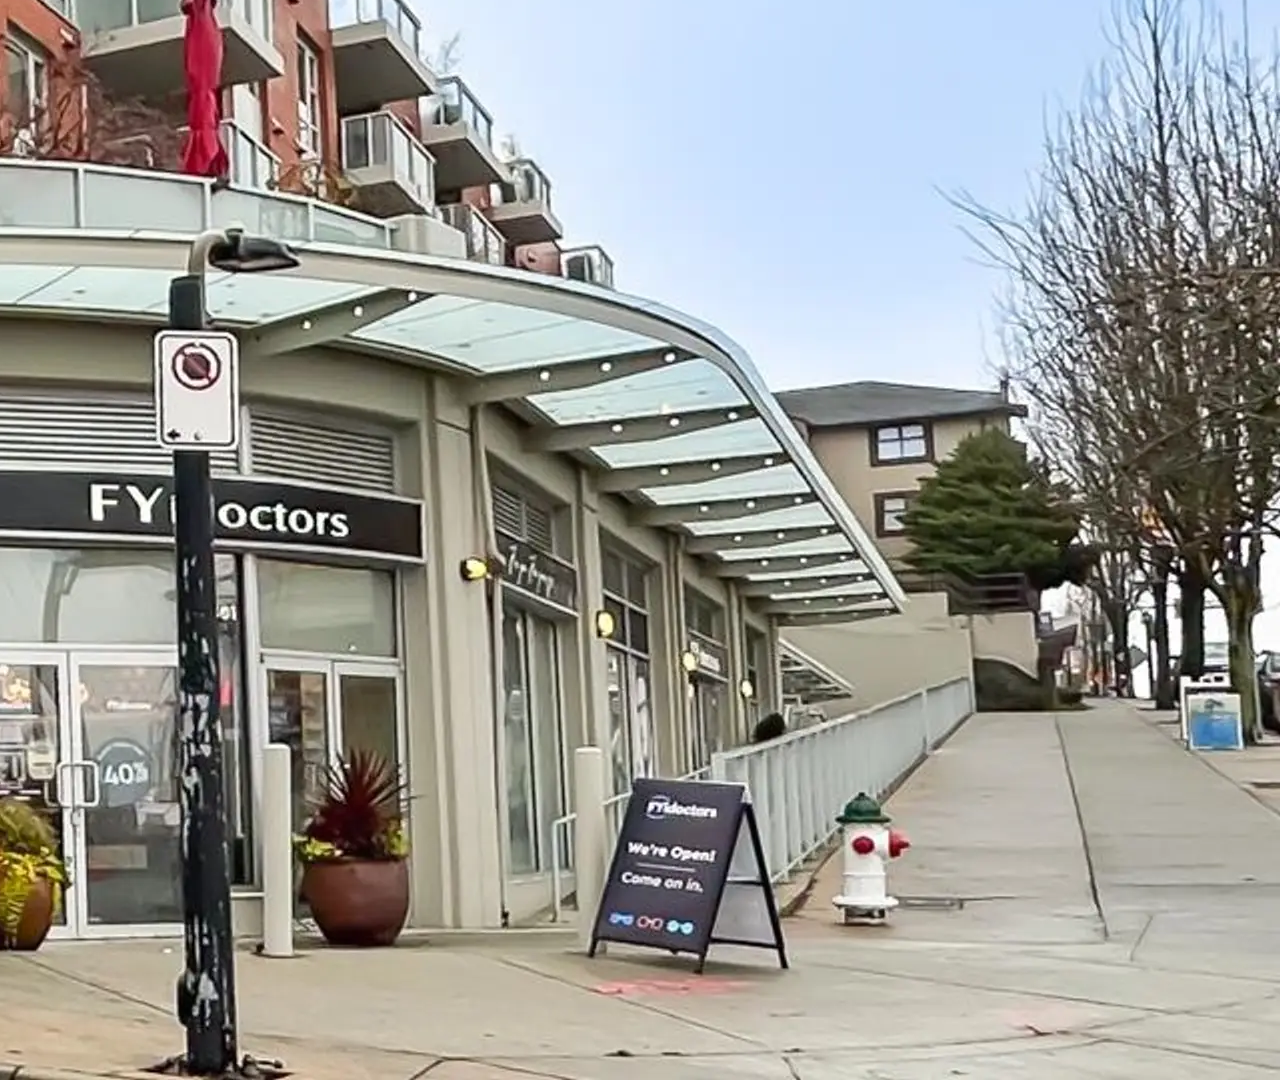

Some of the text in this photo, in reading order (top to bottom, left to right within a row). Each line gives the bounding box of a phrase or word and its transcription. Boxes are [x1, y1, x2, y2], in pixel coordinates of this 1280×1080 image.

[90, 484, 349, 537] FYioctors
[628, 842, 716, 862] We're Open!
[622, 872, 703, 893] Come on in.
